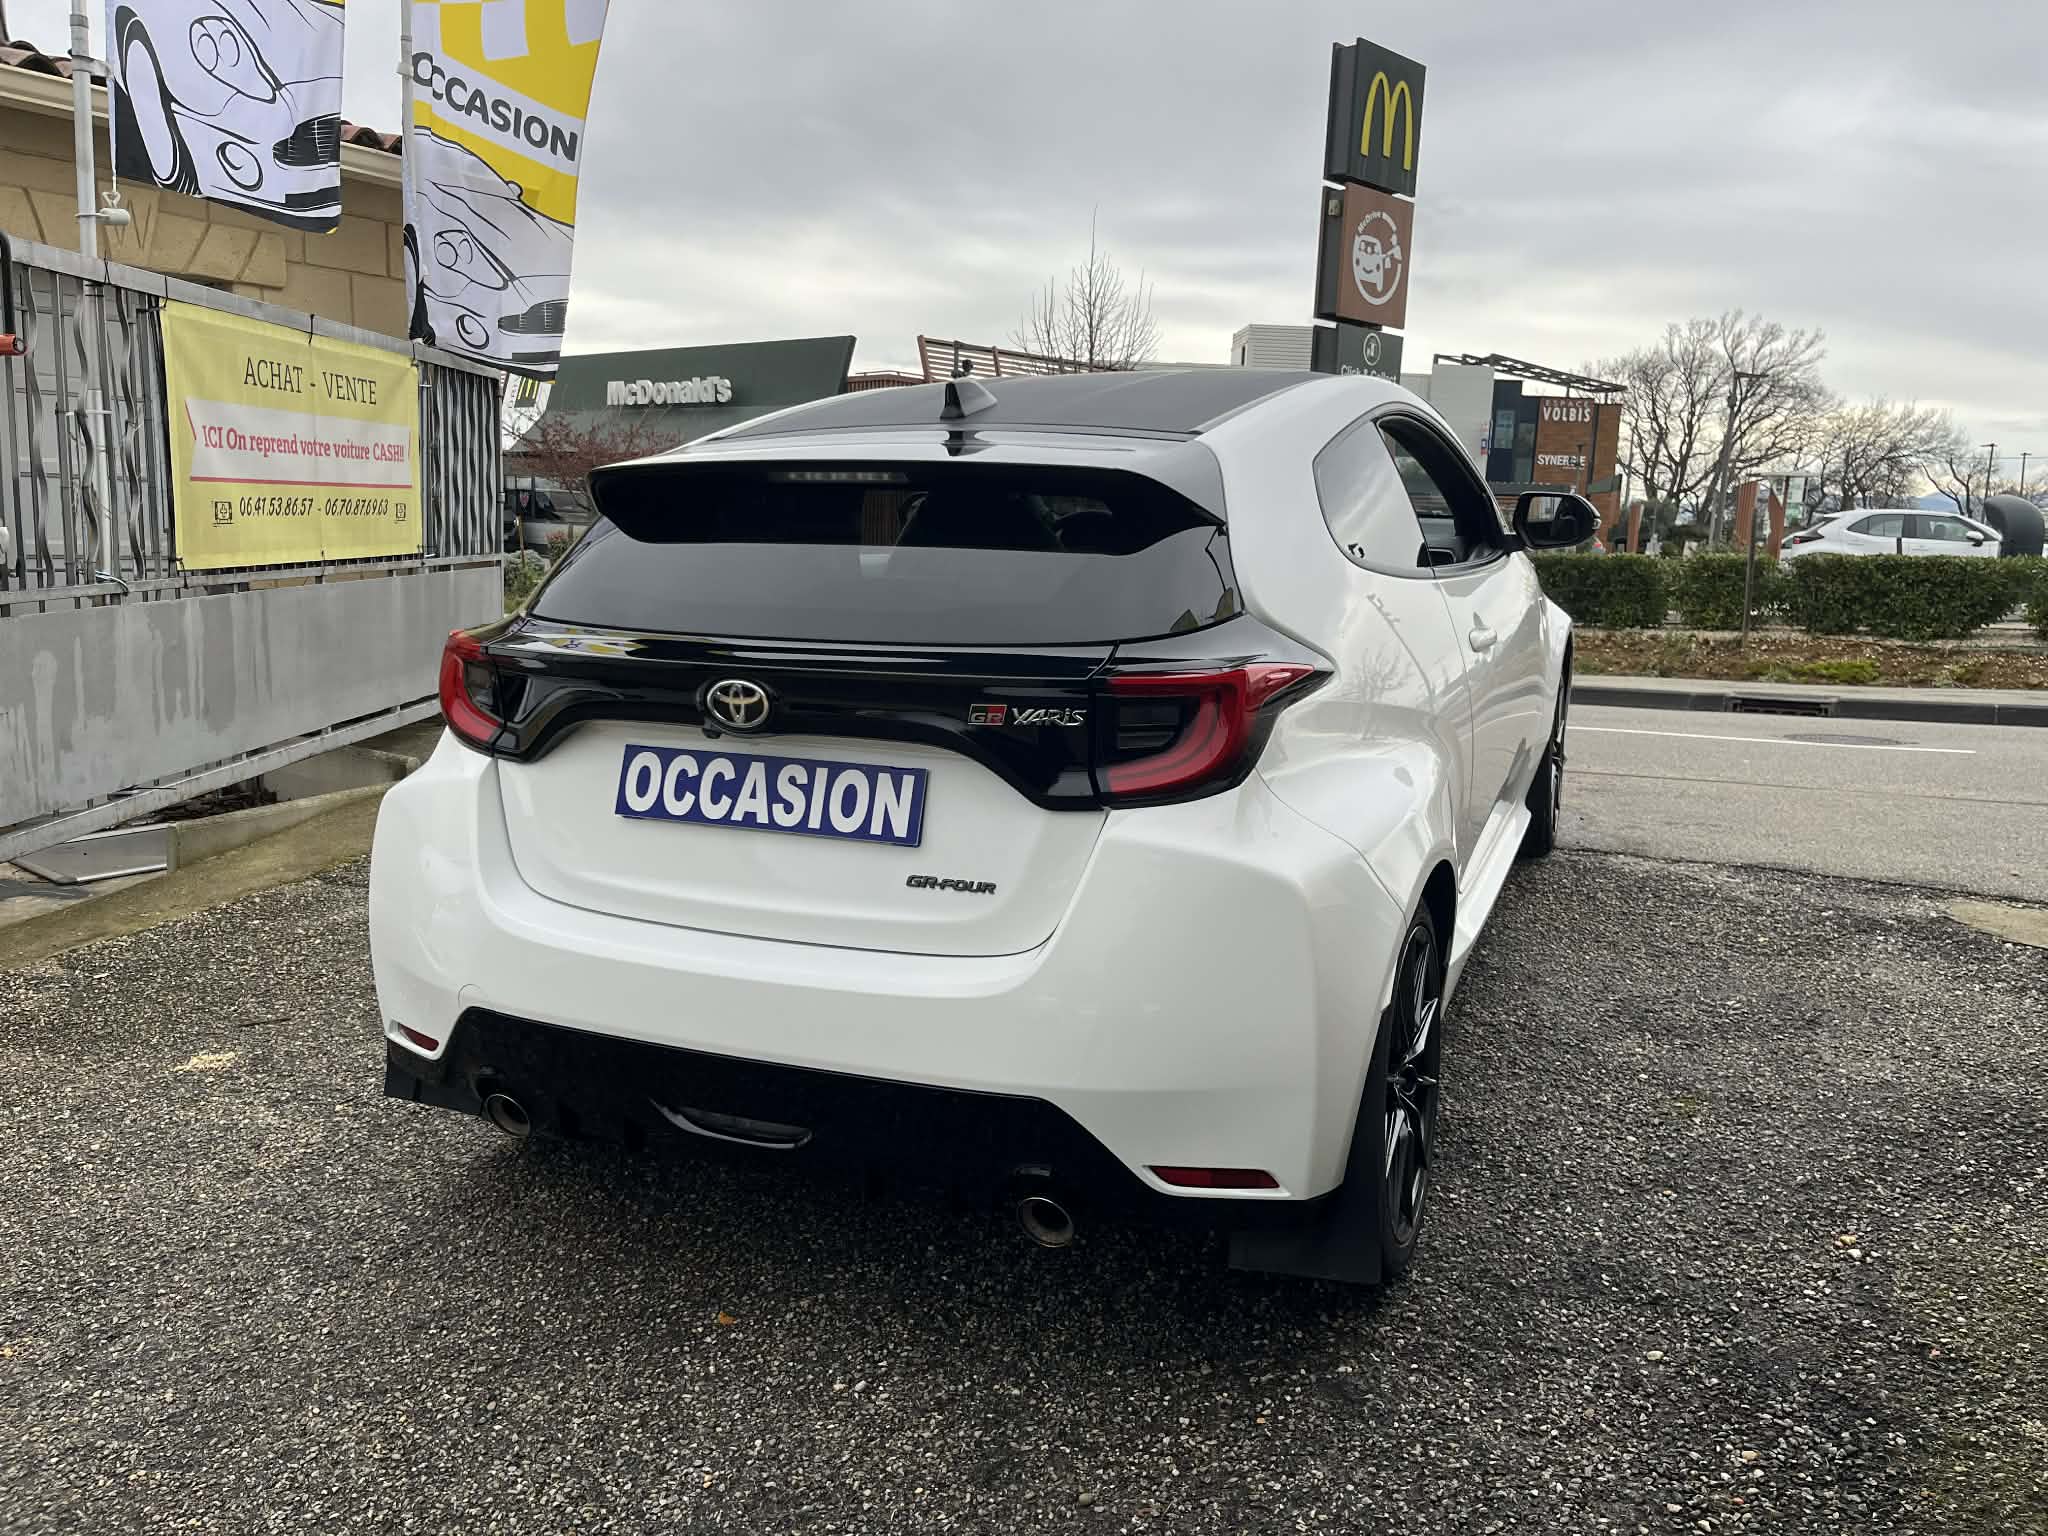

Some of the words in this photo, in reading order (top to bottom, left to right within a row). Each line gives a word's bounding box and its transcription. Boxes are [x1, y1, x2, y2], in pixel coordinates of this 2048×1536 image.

[412, 52, 578, 161] OCCASION
[243, 356, 303, 393] ACHAT
[322, 371, 377, 405] VENTE
[607, 376, 732, 406] McDonald's
[1543, 407, 1591, 422] VOLBIS
[202, 425, 223, 449] ICI
[226, 428, 247, 450] On
[249, 433, 298, 457] reprend
[299, 439, 331, 457] votre
[332, 439, 370, 460] voiture
[372, 443, 405, 463] CASH!!
[239, 496, 314, 517] 06.41.53.86.57
[624, 751, 916, 838] OCCASION
[906, 875, 997, 895] GR-FOUR
